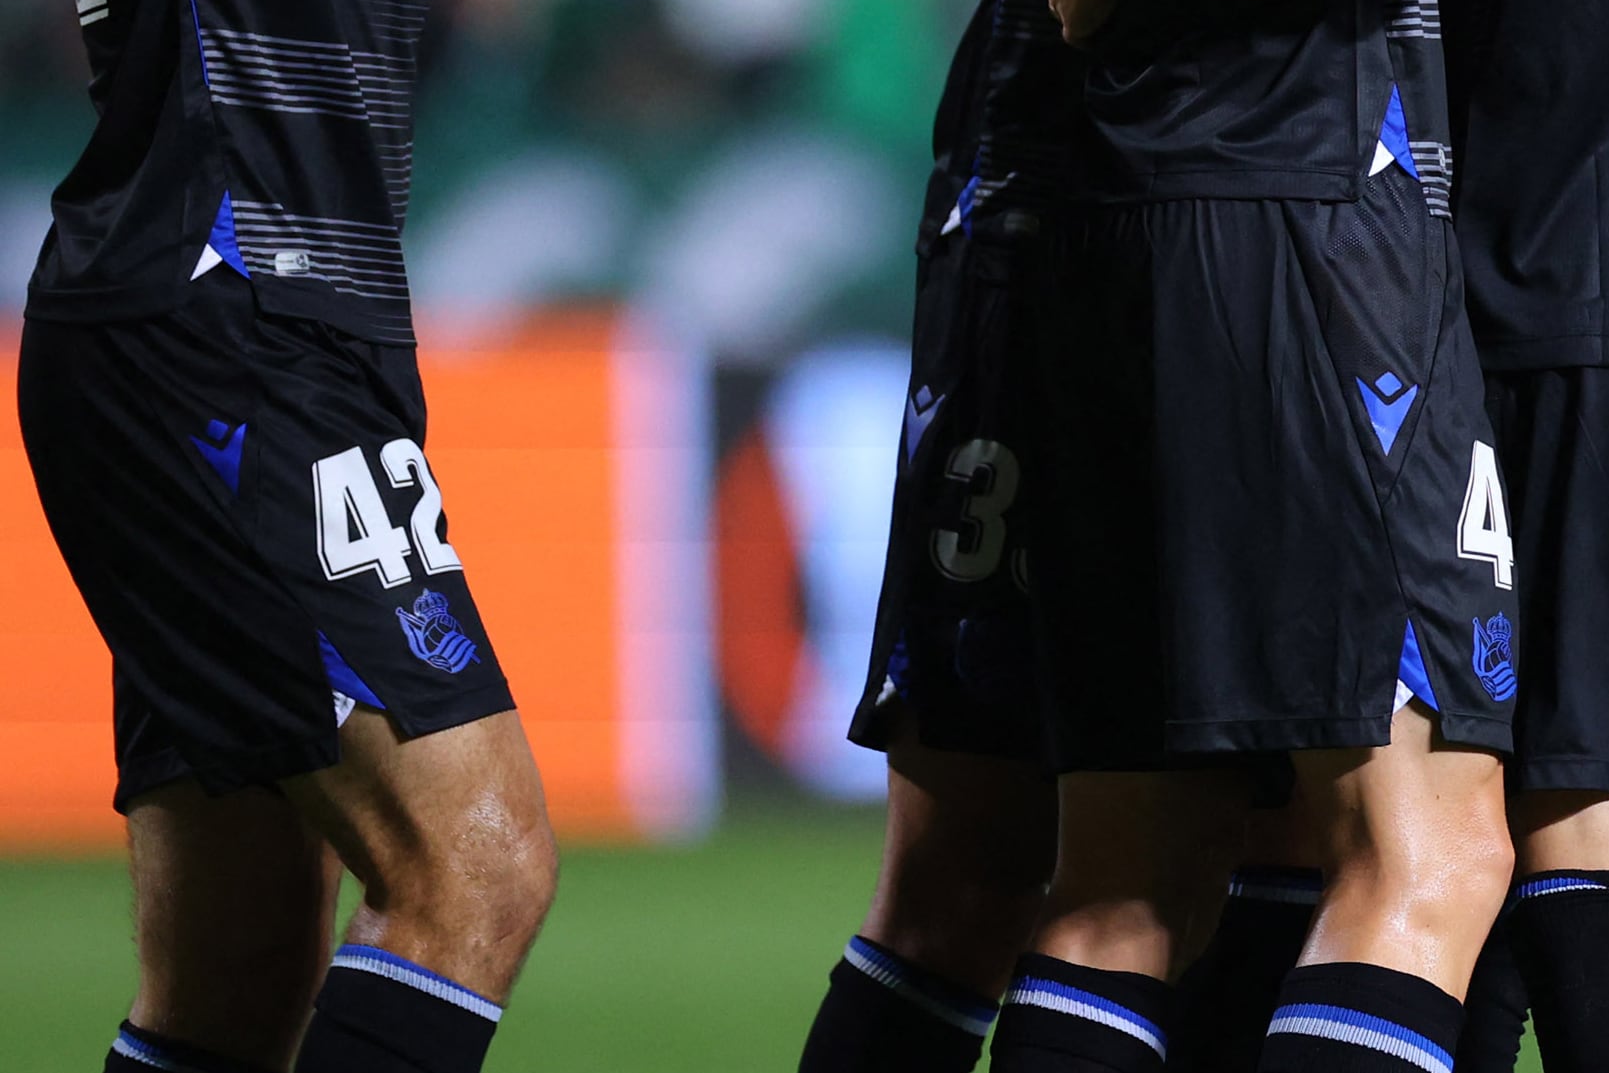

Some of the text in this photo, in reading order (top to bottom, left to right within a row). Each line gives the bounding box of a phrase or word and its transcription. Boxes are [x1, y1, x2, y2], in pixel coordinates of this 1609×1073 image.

[311, 437, 464, 590] 42
[928, 436, 1033, 596] 3
[1456, 439, 1516, 591] 4
